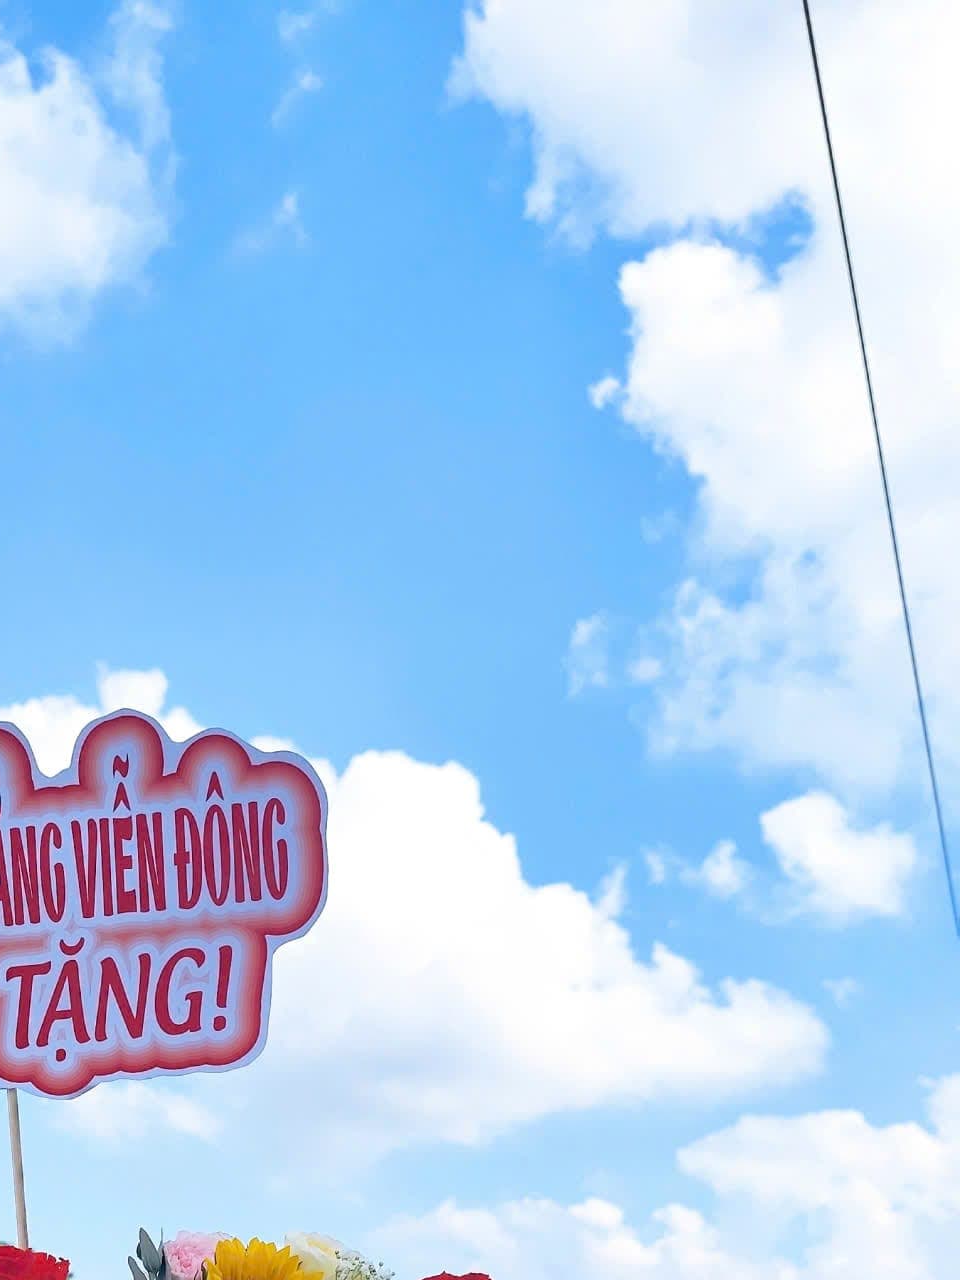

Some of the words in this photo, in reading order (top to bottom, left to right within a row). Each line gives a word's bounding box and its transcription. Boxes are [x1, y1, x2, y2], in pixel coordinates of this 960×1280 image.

[71, 754, 167, 919] VIỄN
[173, 771, 289, 910] ĐÔNG
[5, 937, 233, 1061] TẶNG!
